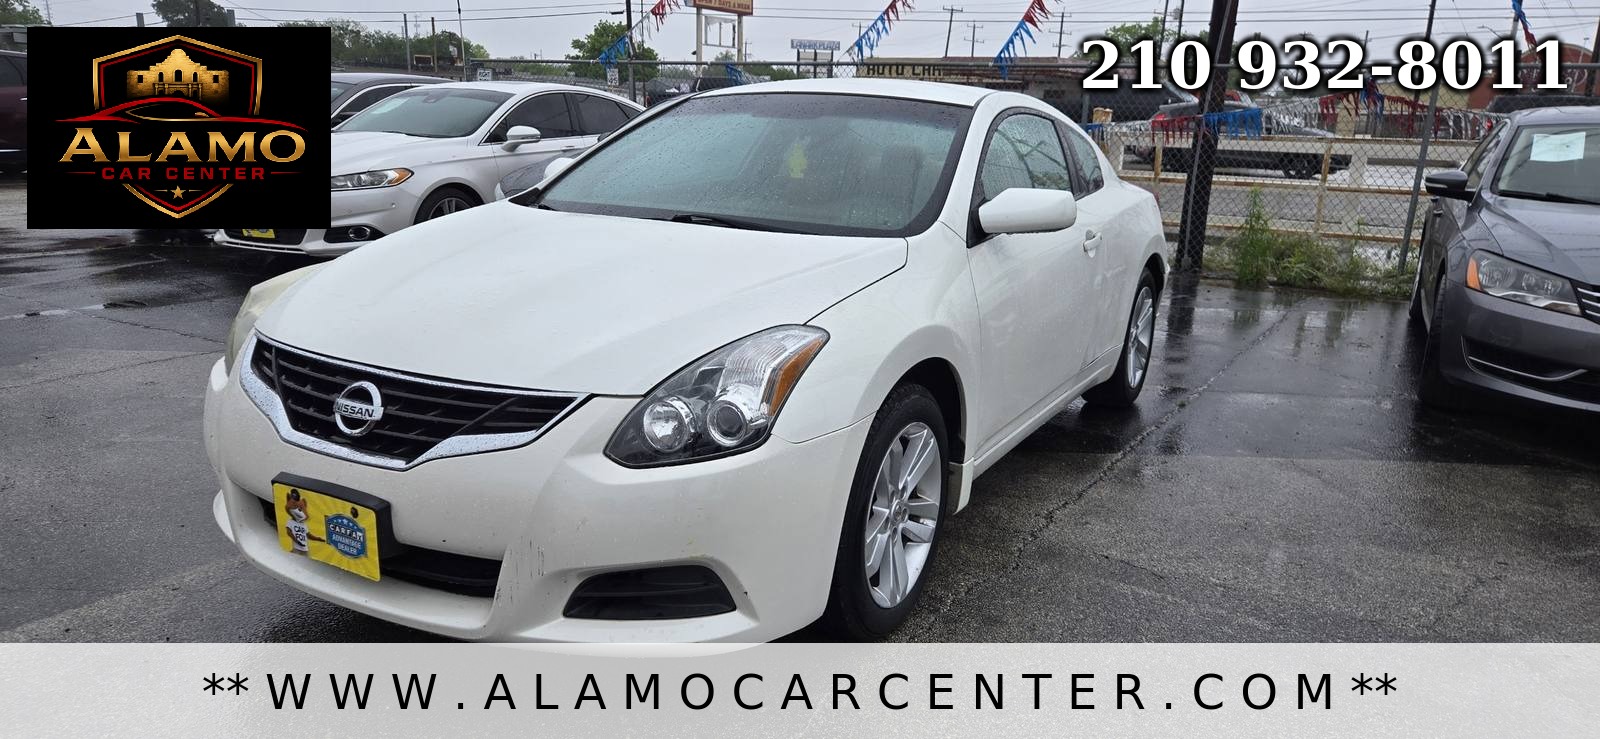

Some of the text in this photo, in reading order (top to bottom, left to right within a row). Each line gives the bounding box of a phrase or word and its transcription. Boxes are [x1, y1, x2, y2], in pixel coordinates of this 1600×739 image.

[818, 41, 839, 50] PLAZA
[867, 64, 942, 76] AUTO CAR
[336, 402, 374, 418] NISSAN
[294, 525, 305, 534] CAR
[330, 524, 363, 542] CARFAX
[332, 534, 361, 549] ADVANTAGE
[337, 543, 358, 555] DEALER
